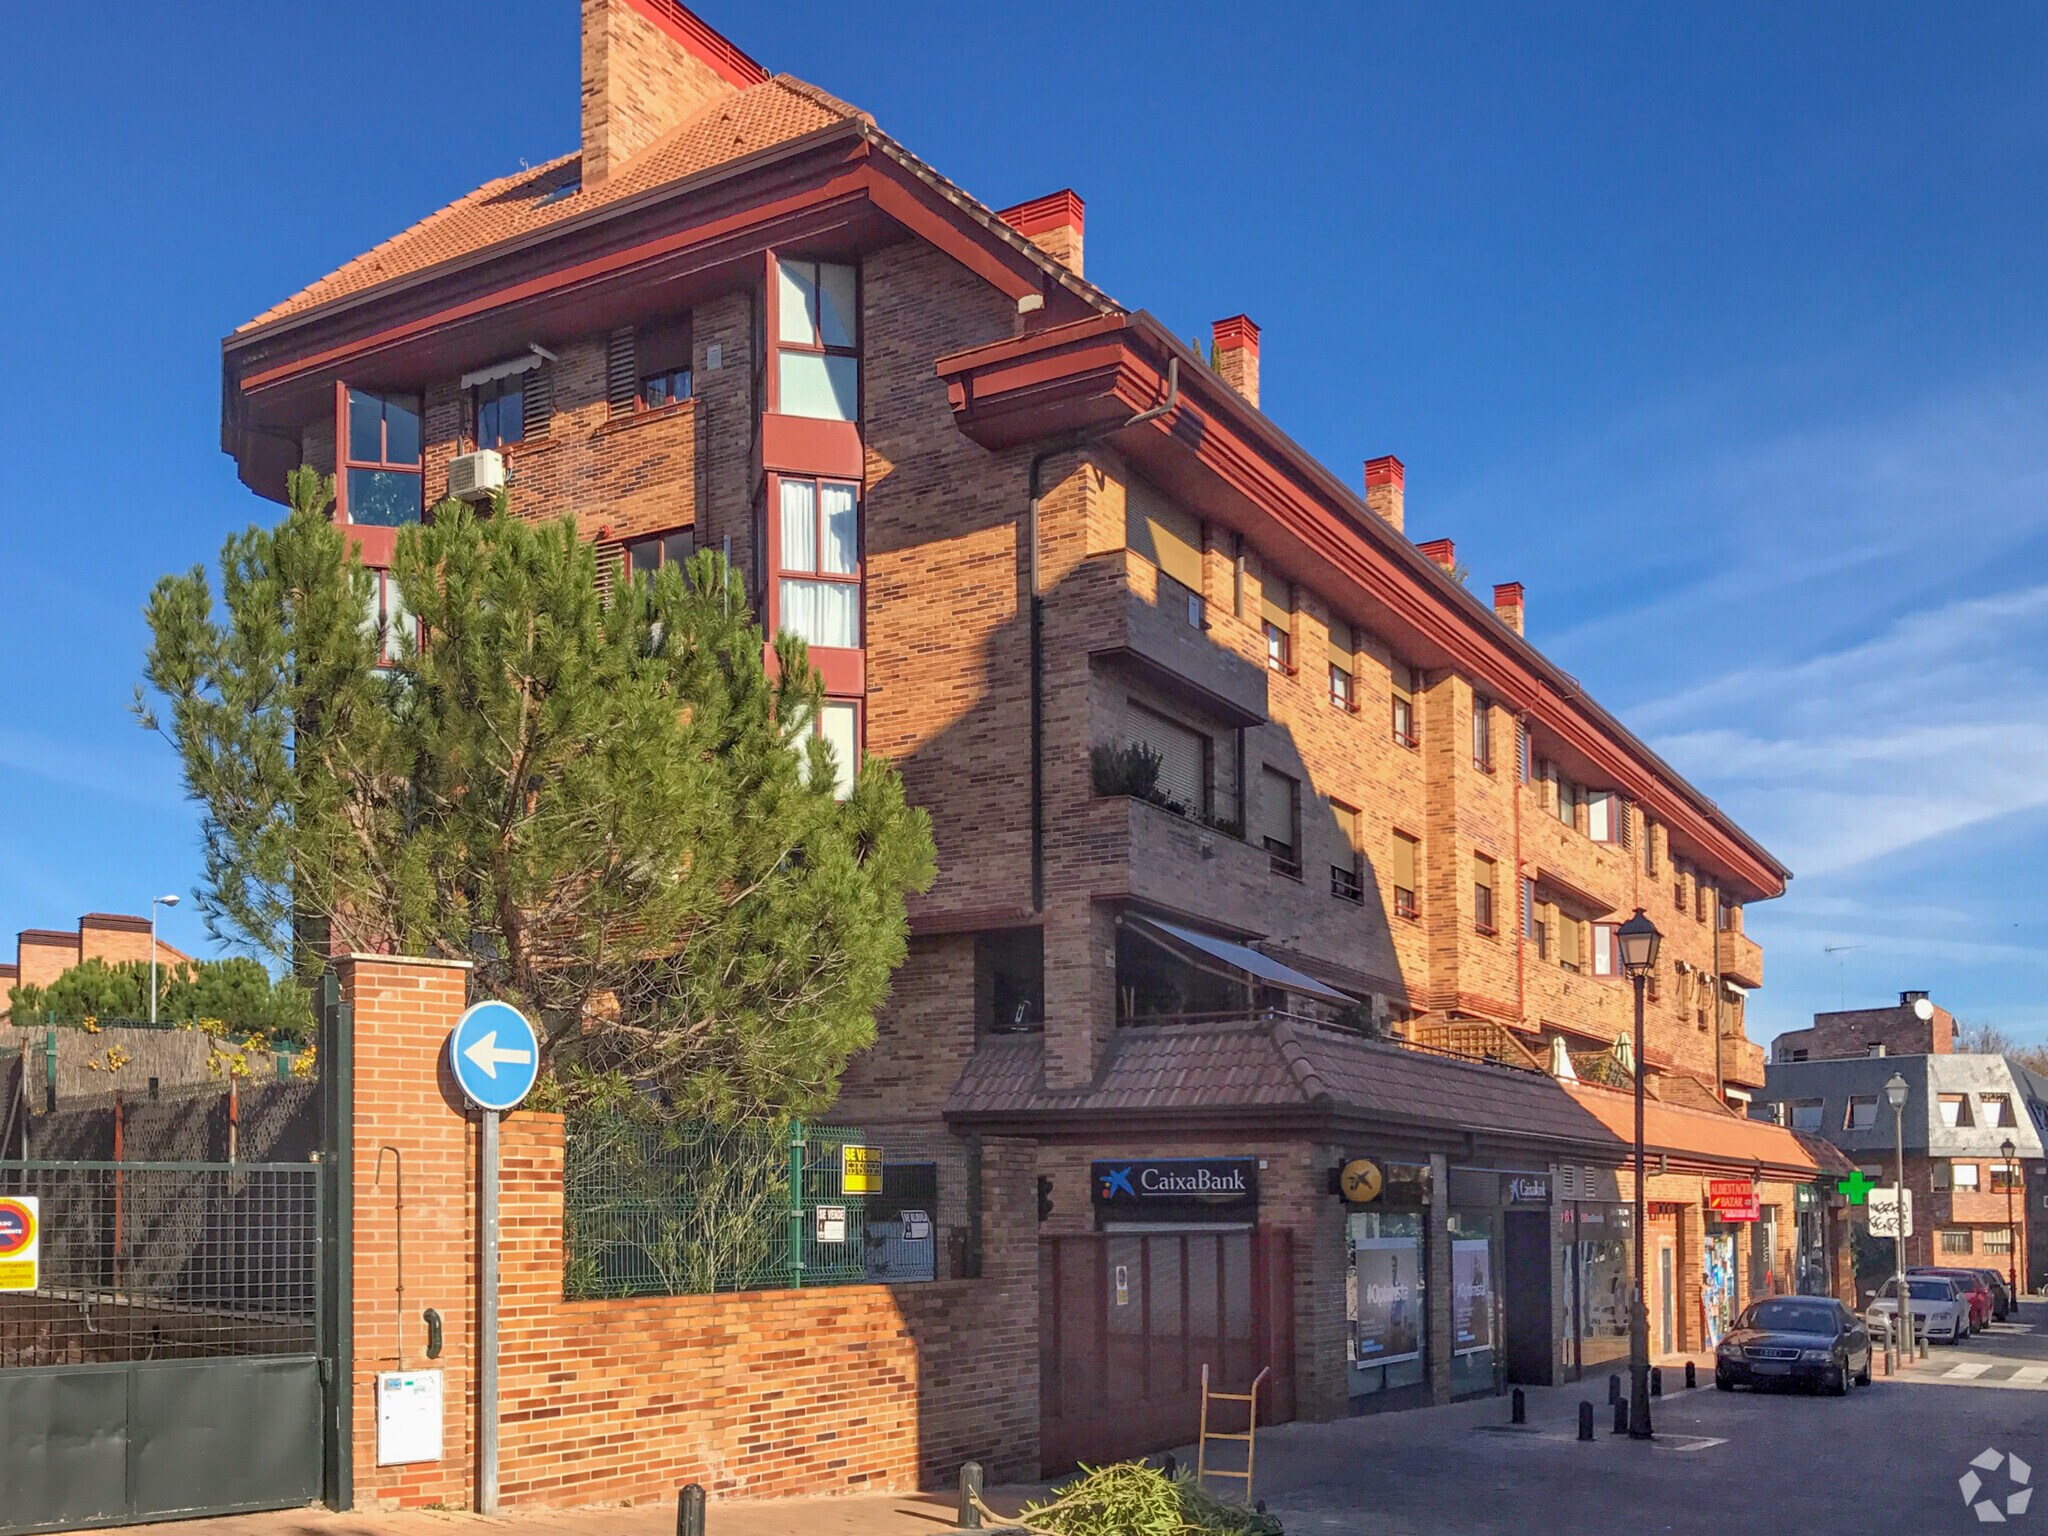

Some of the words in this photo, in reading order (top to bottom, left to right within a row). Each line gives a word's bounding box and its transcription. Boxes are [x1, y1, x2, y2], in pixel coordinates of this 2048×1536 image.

[845, 1148, 856, 1161] SE
[857, 1148, 881, 1162] VENDE
[1141, 1168, 1246, 1190] CaixaBank
[1520, 1178, 1546, 1197] CaixaBank
[1720, 1196, 1743, 1208] BAZAR
[819, 1209, 827, 1220] SE
[827, 1208, 845, 1220] VENDE
